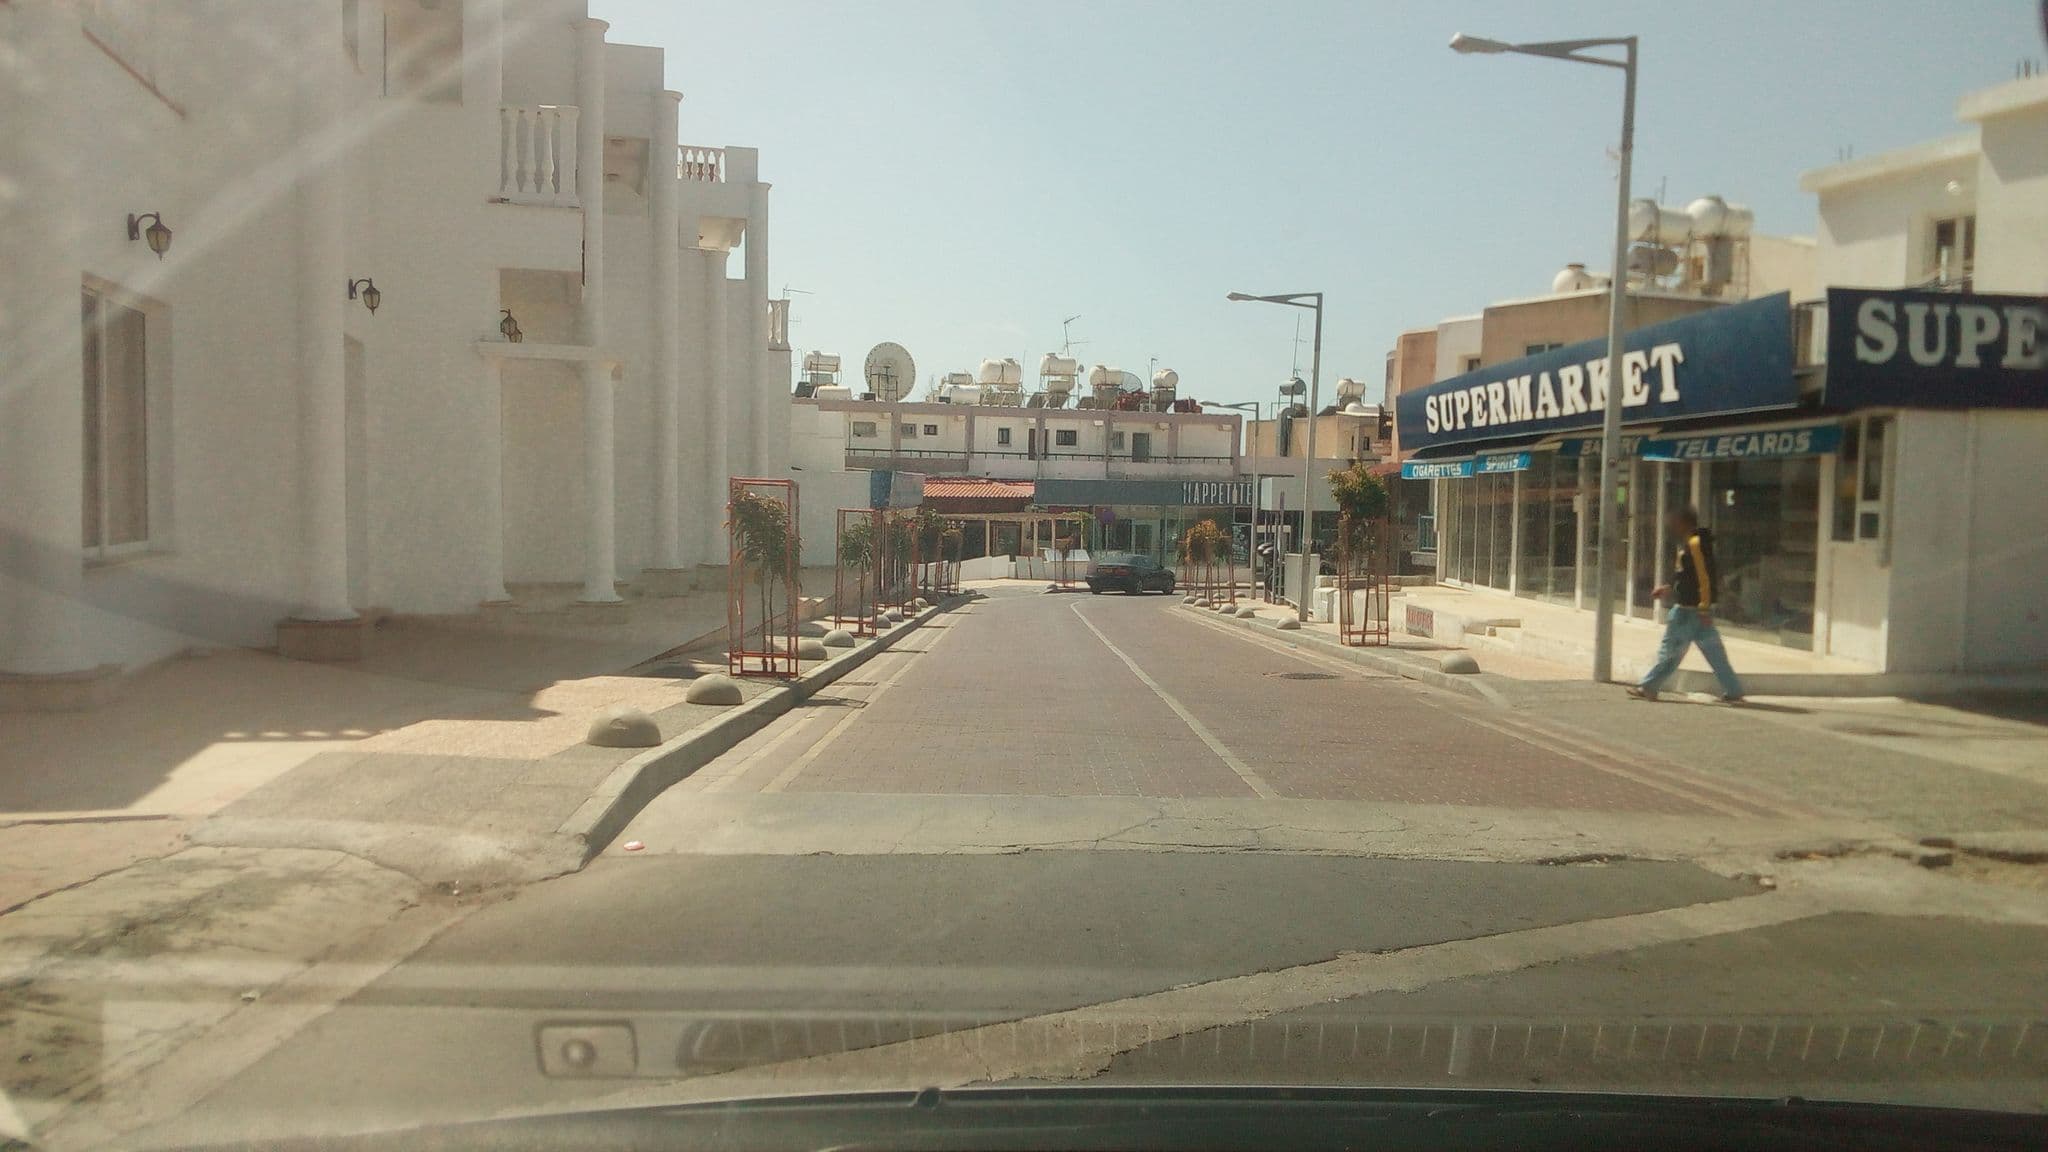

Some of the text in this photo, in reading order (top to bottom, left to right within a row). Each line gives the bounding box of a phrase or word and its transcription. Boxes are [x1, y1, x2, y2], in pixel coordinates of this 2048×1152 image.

[1425, 342, 1684, 434] SUPERMARKET
[1673, 430, 1813, 459] TELECARDS
[1412, 463, 1472, 478] CIGARETTES
